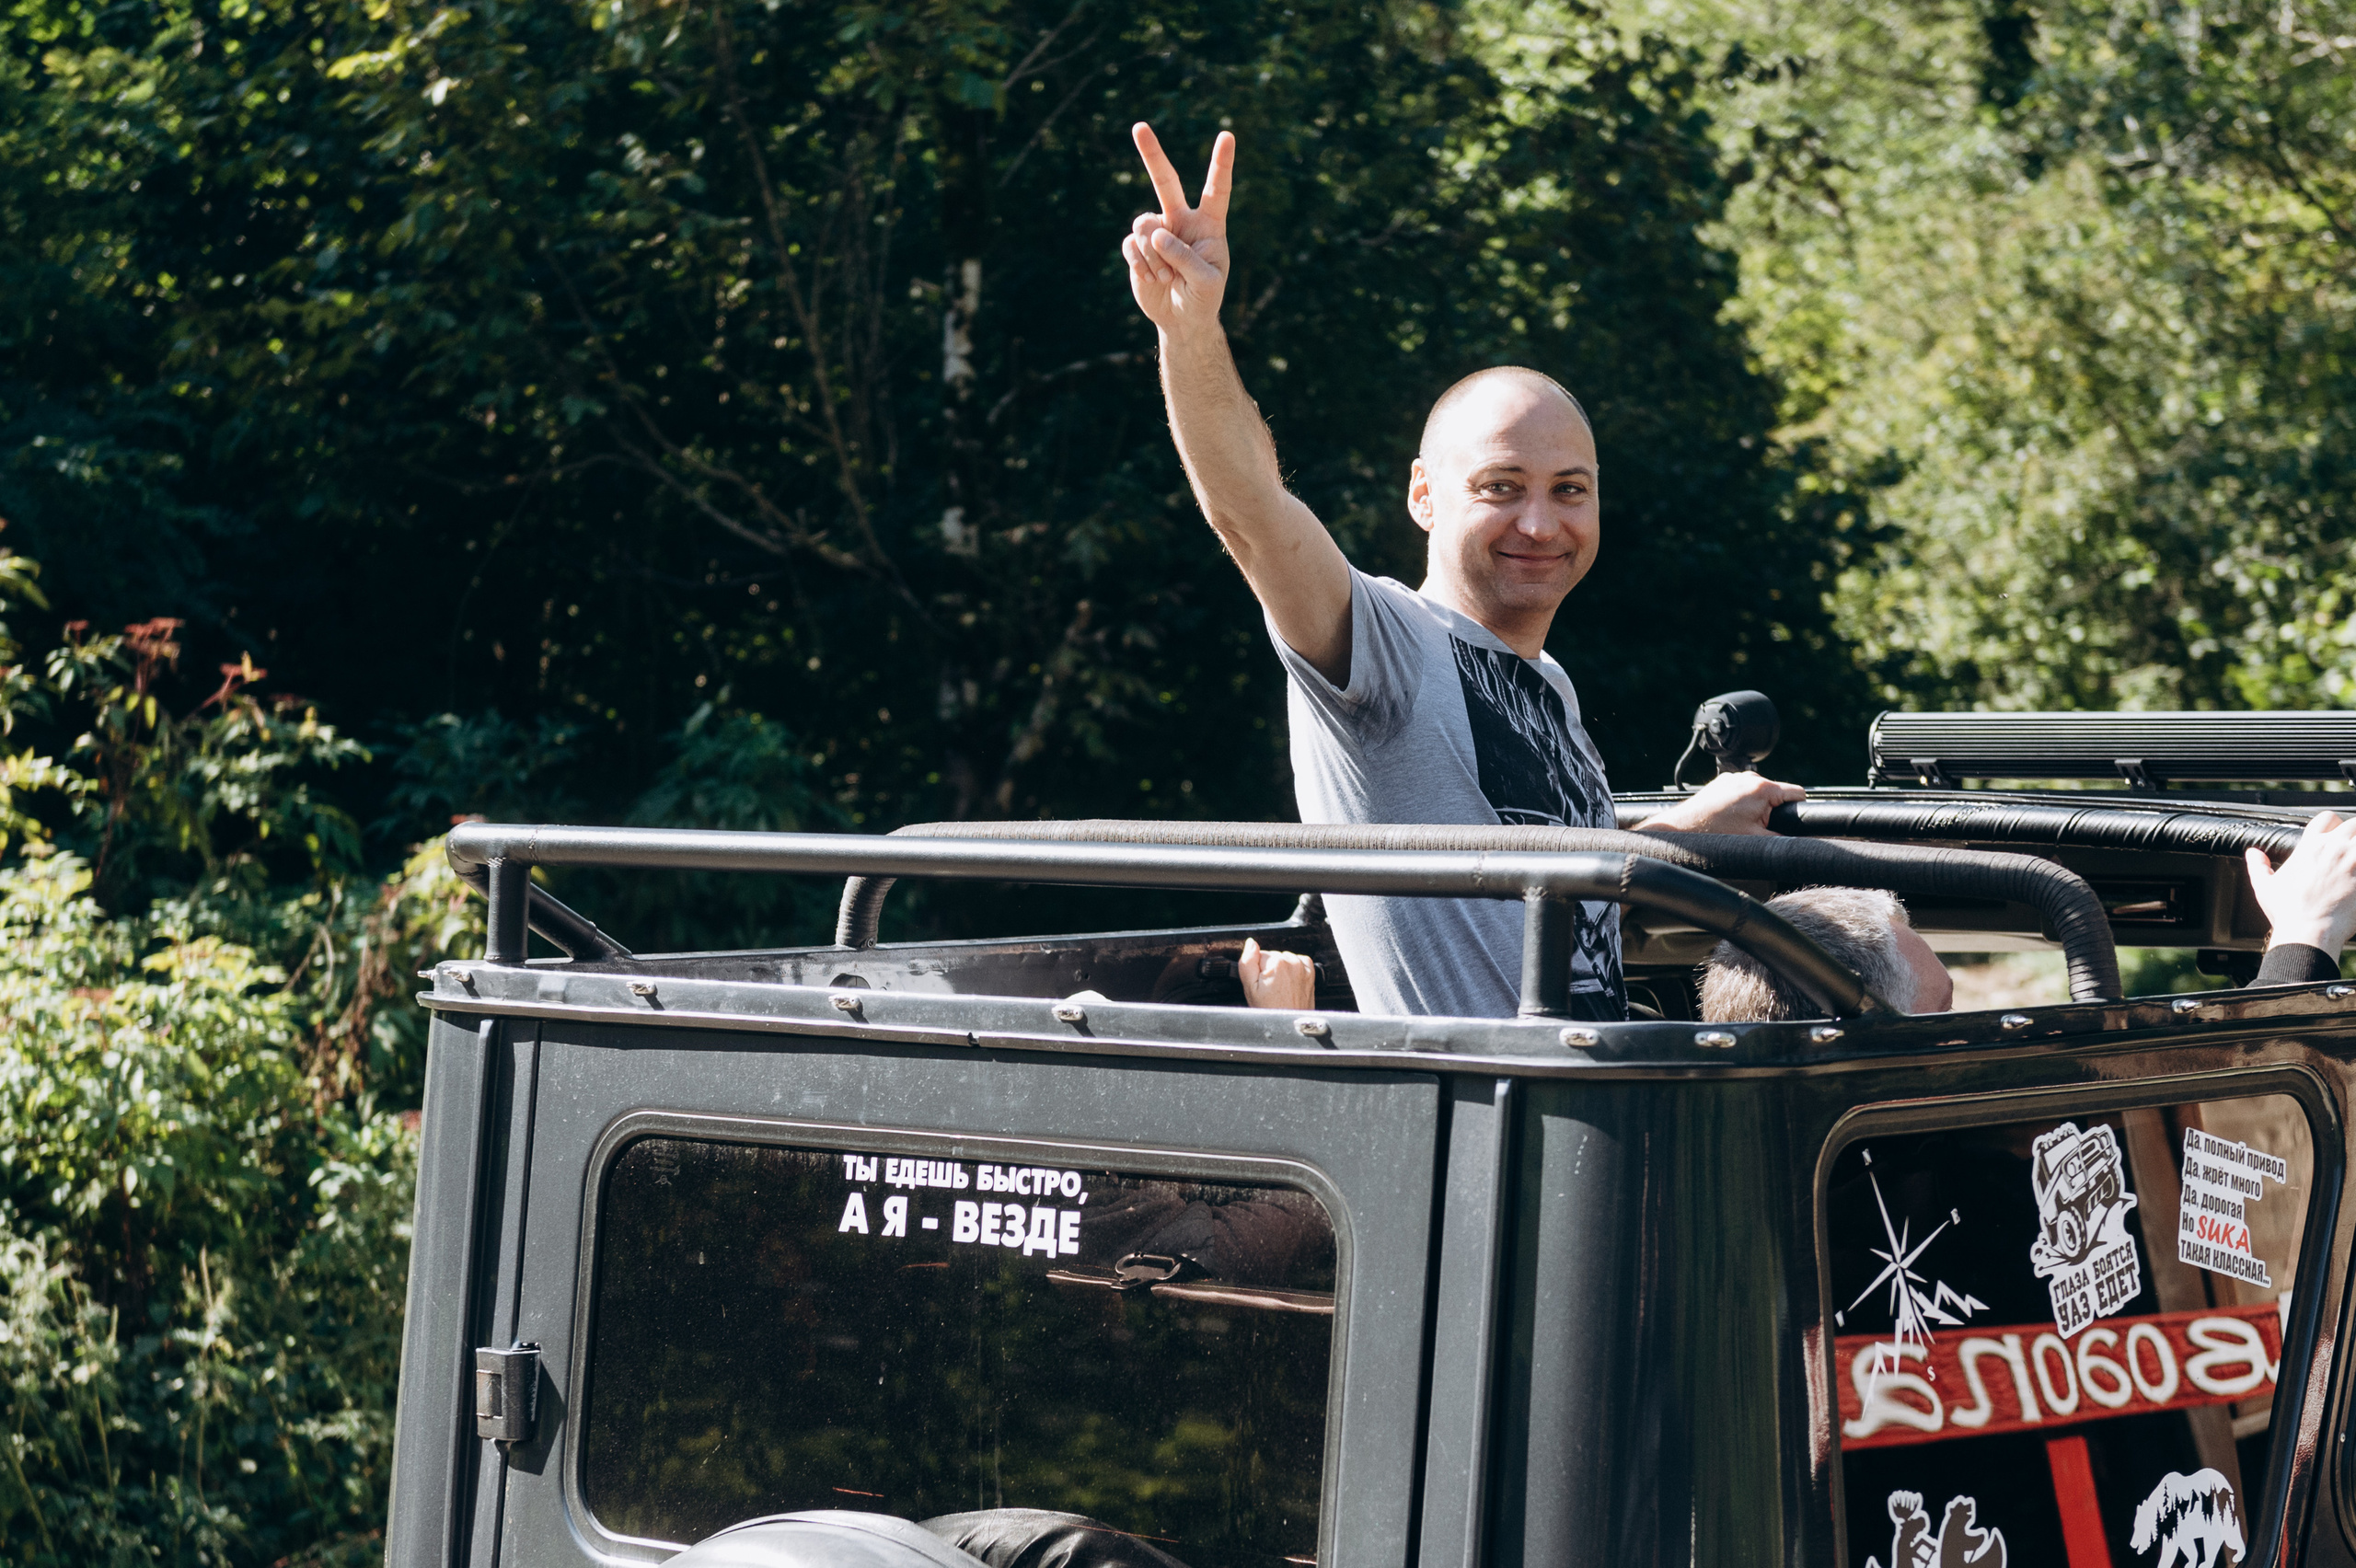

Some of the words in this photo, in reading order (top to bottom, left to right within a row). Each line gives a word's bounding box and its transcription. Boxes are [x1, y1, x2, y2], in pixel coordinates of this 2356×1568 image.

[843, 1154, 878, 1182] ТЫ
[884, 1158, 969, 1190] ЕДЕШЬ
[976, 1164, 1089, 1205] БЫСТРО,
[2184, 1157, 2200, 1181] Да,
[2202, 1165, 2229, 1187] жрёт
[2231, 1176, 2261, 1198] много
[2186, 1129, 2202, 1152] Да,
[2204, 1138, 2246, 1166] полный
[2246, 1152, 2285, 1181] привод
[838, 1192, 870, 1235] А
[881, 1195, 908, 1238] Я
[952, 1200, 1081, 1259] ВЕЗДЕ
[2183, 1184, 2199, 1207] Да,
[2200, 1193, 2243, 1220] дорогая
[2181, 1211, 2195, 1233] Но
[2196, 1214, 2251, 1254] SUKA
[2052, 1271, 2090, 1305] ГЛАЗА
[2092, 1240, 2134, 1280] БОЯТСЯ
[2180, 1239, 2211, 1266] ТАКАЯ
[2212, 1248, 2270, 1286] КЛАССНАЯ...
[2056, 1294, 2092, 1332] УАЗ
[2095, 1261, 2139, 1309] ЕДЕТ
